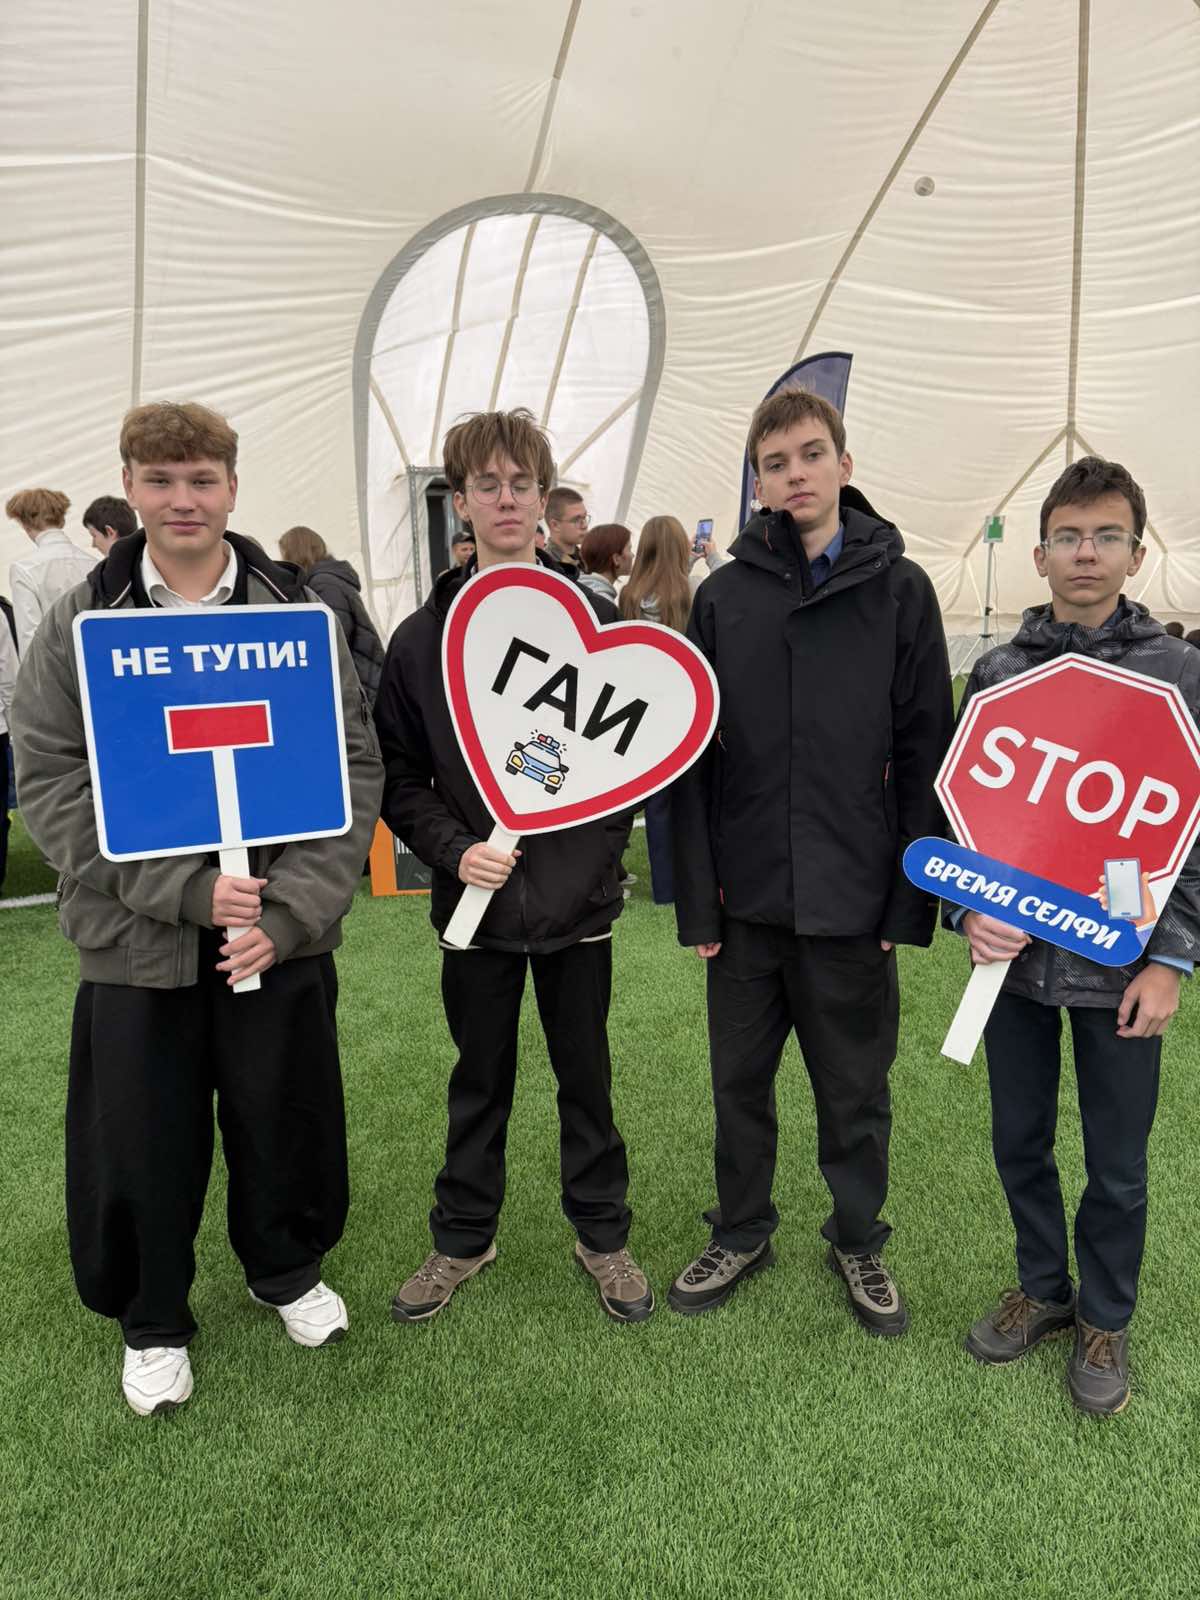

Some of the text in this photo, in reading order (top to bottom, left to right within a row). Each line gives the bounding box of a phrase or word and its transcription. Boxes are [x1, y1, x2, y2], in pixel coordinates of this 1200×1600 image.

[111, 640, 308, 677] НЕ ТУПИ!
[491, 636, 649, 757] ГАИ
[968, 726, 1180, 839] STOP
[923, 856, 1121, 950] ВРЕМЯ СЕЛФИ
